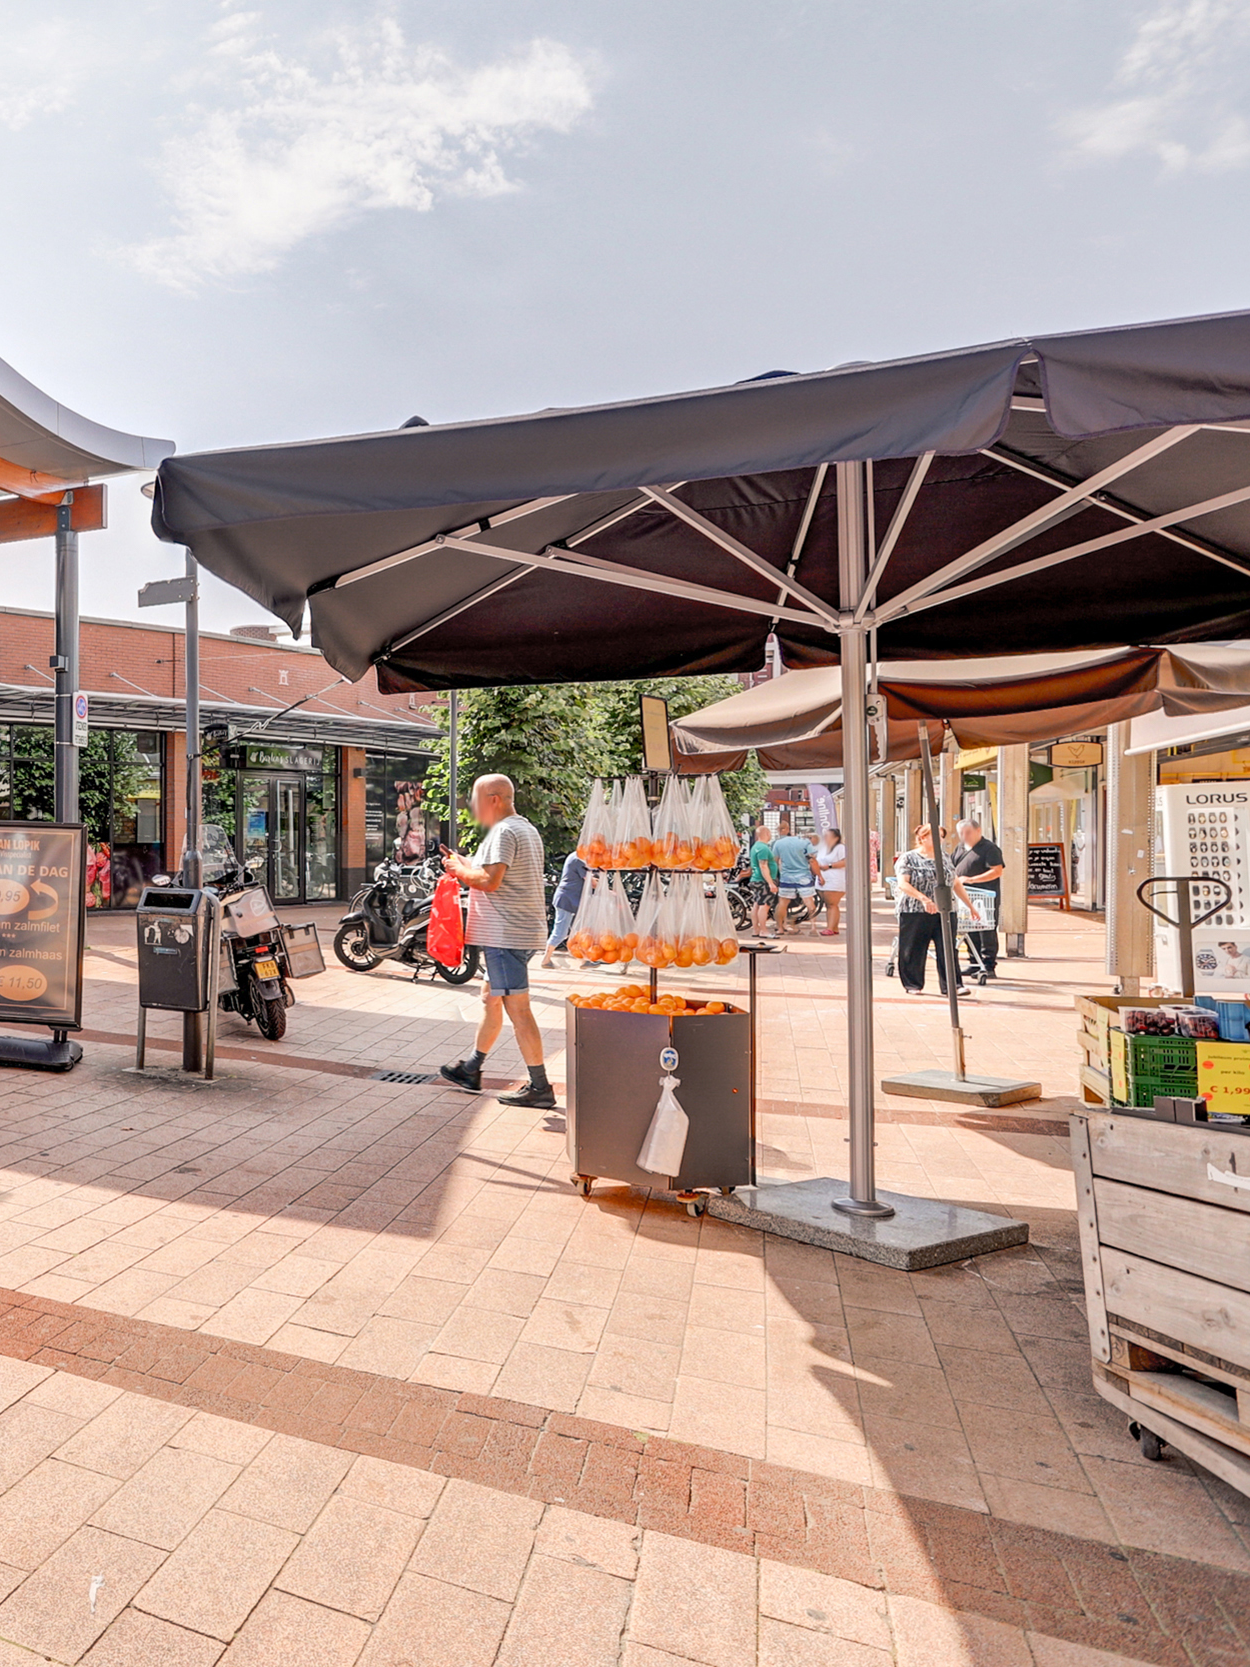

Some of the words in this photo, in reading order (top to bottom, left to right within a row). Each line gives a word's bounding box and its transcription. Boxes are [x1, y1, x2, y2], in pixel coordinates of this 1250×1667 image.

[285, 756, 320, 766] SLAGERIJ
[1186, 792, 1248, 805] LORUS
[12, 840, 40, 851] LOPIK
[0, 849, 32, 859] Visspecialist
[17, 864, 35, 876] DE
[39, 866, 69, 878] DAG
[14, 921, 60, 933] zalmfilet
[9, 948, 63, 960] zalmhaas
[9, 977, 43, 990] 11,50
[1223, 1086, 1250, 1095] 1,99
